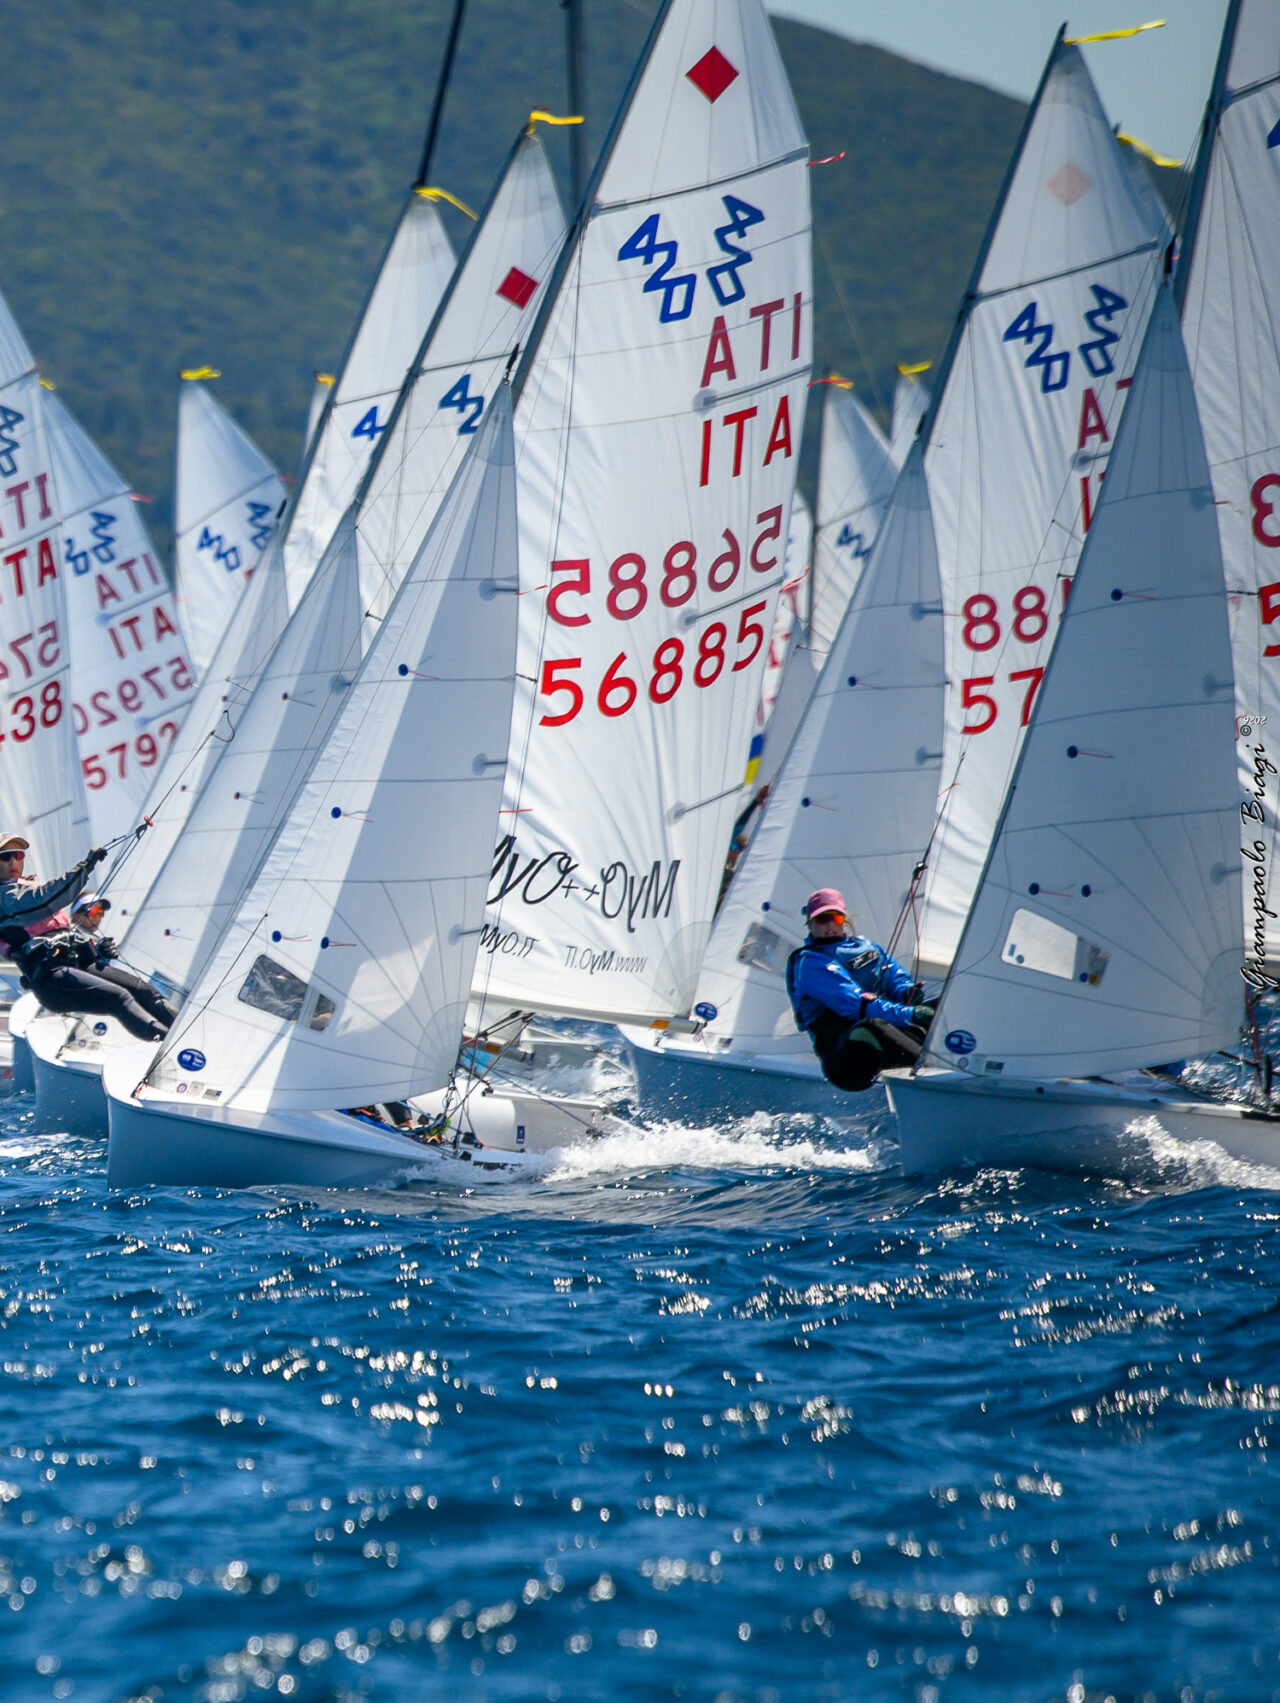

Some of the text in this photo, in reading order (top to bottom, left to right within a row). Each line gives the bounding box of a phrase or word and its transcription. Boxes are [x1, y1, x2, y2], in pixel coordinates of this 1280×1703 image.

[617, 213, 697, 324] 420
[1002, 301, 1071, 394] 420
[700, 396, 793, 487] ITA
[197, 526, 241, 572] 420
[108, 605, 177, 658] ITA
[539, 601, 766, 727] 56885
